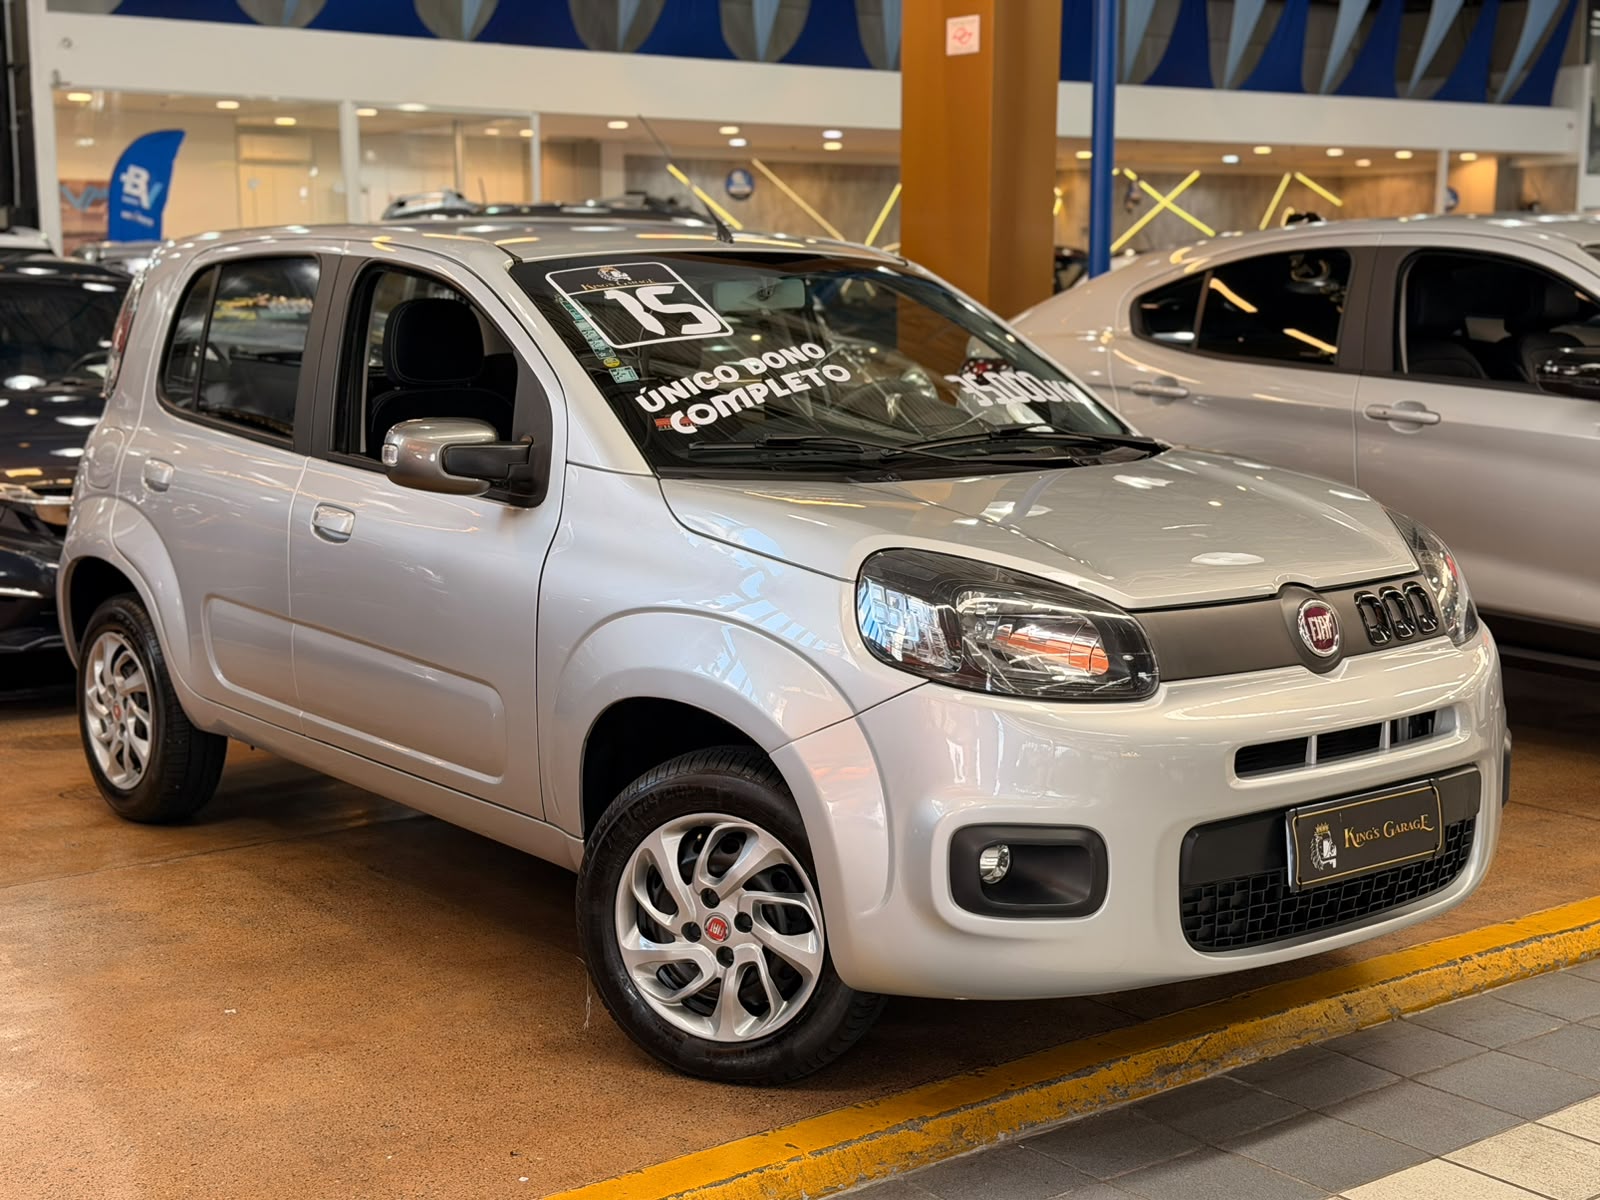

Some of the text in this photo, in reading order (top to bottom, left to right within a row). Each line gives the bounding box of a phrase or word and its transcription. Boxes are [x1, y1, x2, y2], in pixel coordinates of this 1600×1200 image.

[603, 285, 722, 336] 15
[635, 365, 740, 413] ÚNICO
[740, 342, 826, 375] DONO
[670, 364, 851, 434] COMPLETO
[1307, 612, 1333, 642] FIAT
[1343, 813, 1435, 848] KING'S GARAGE
